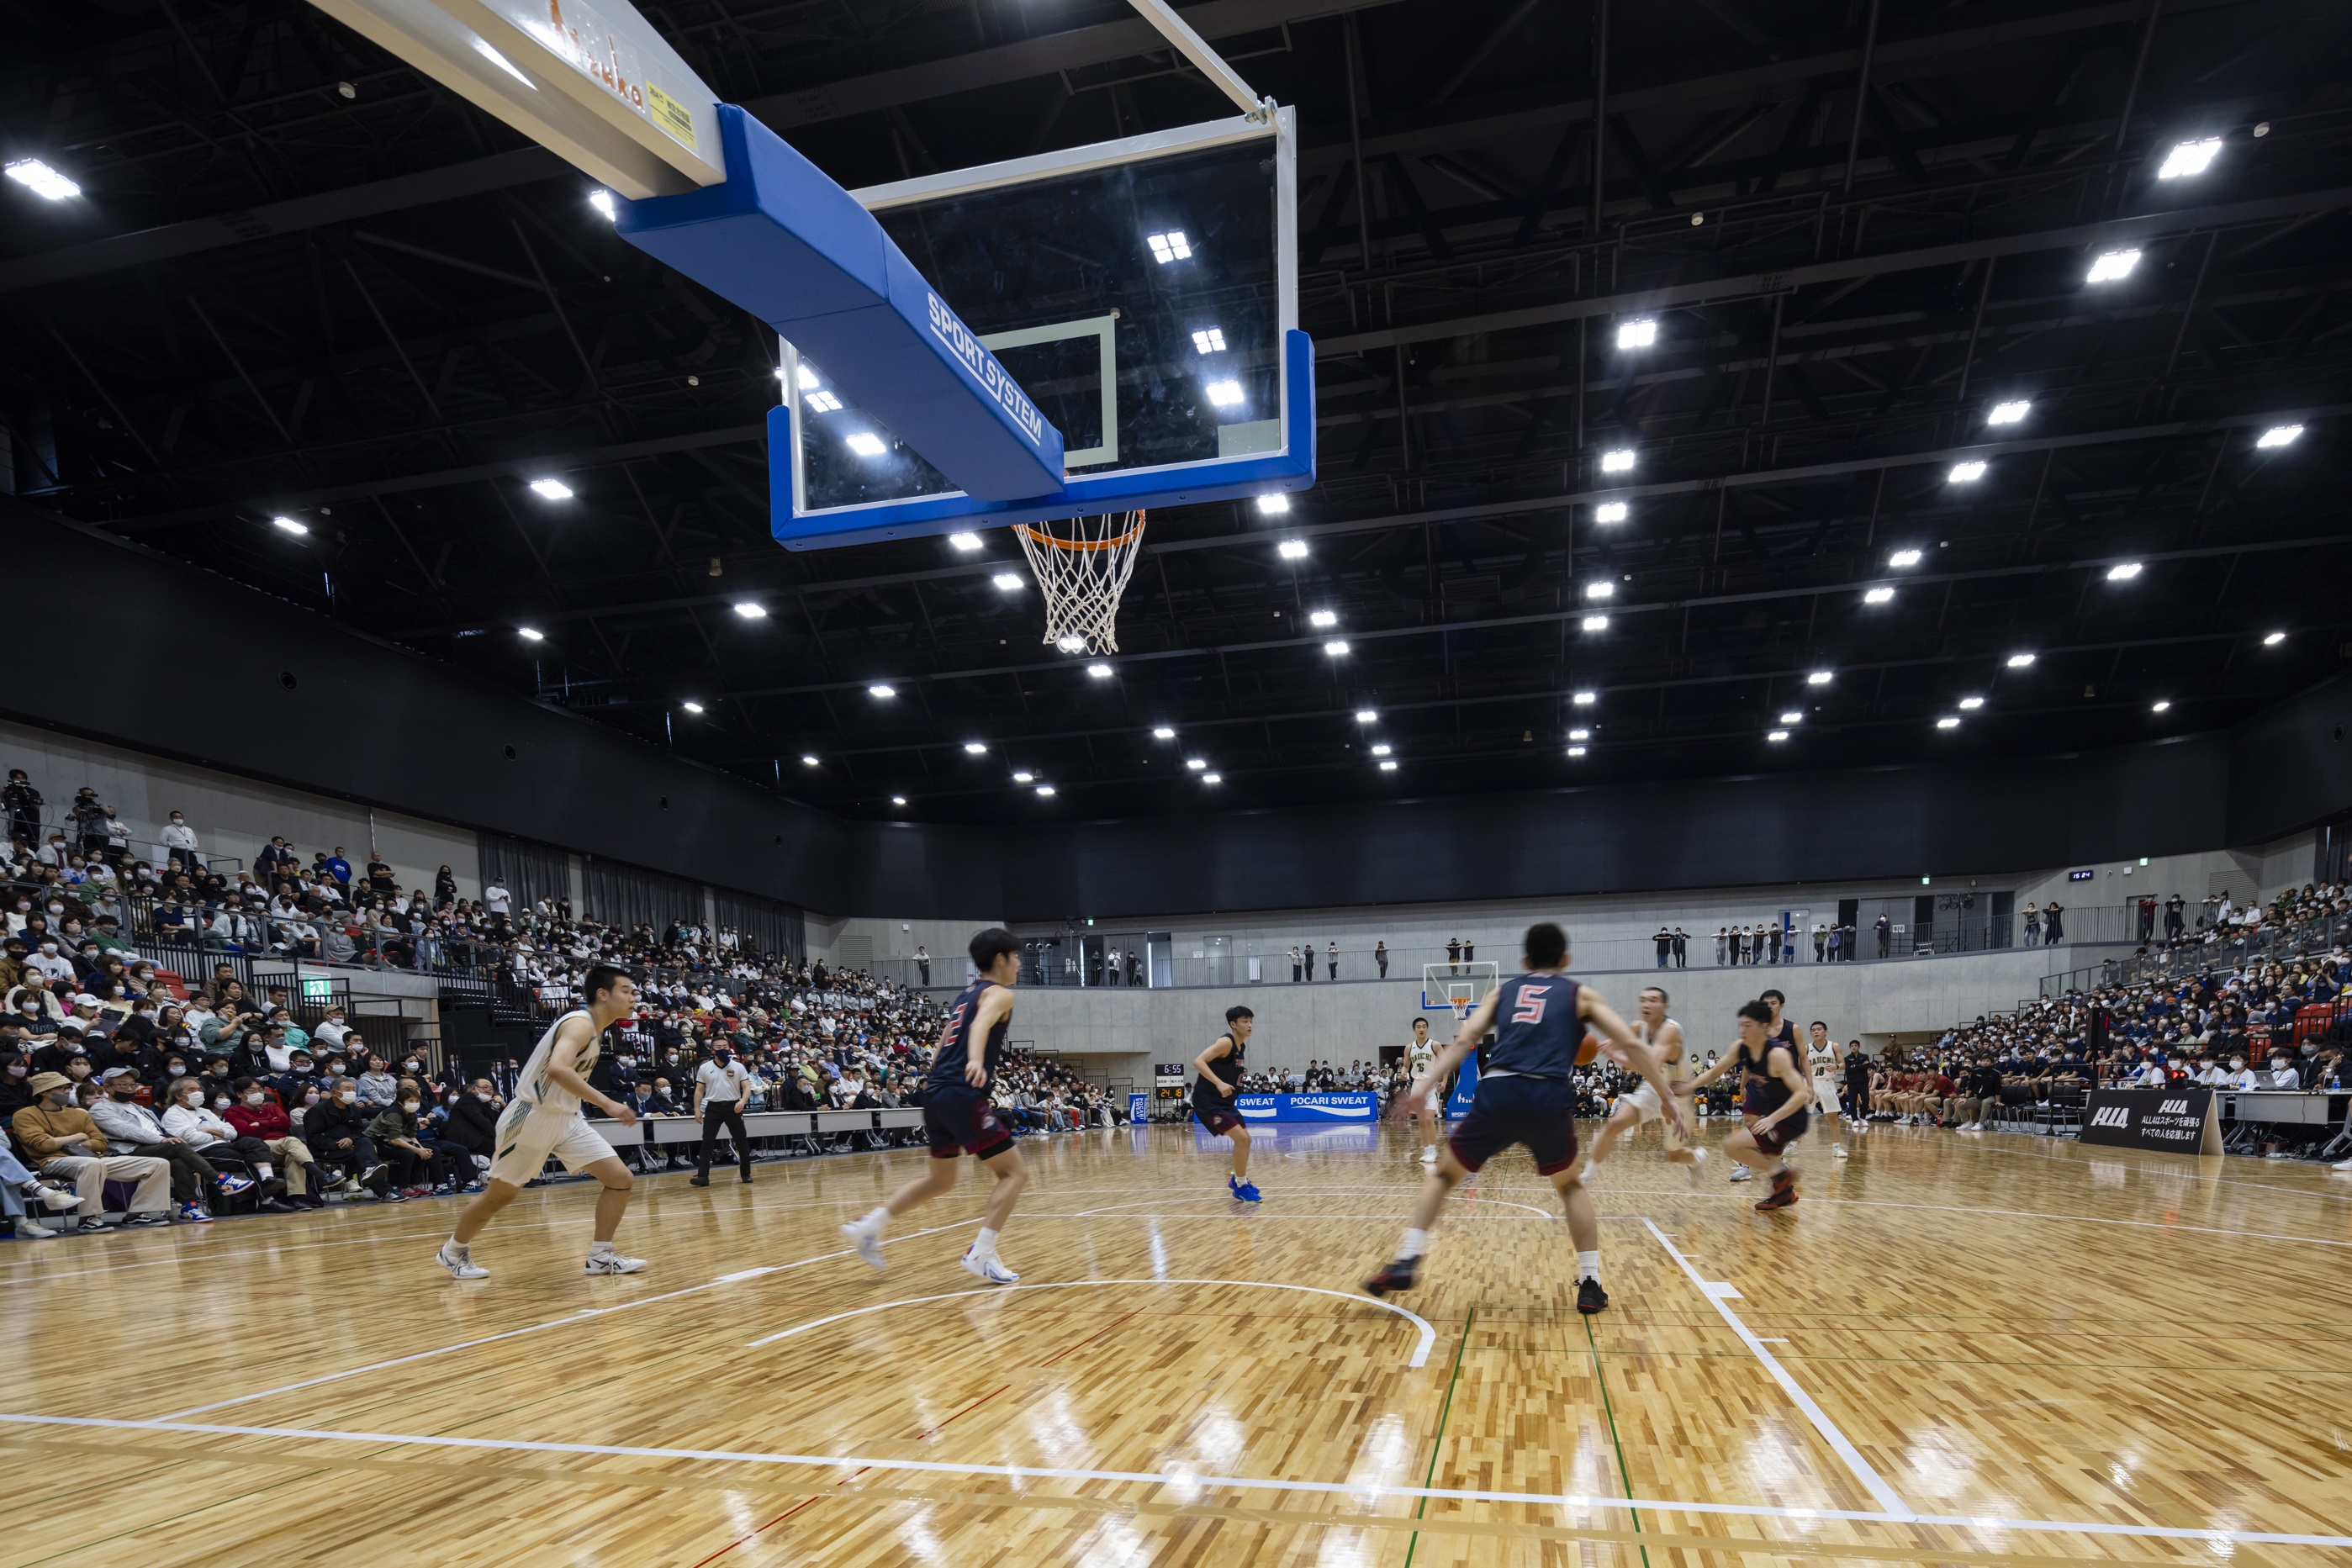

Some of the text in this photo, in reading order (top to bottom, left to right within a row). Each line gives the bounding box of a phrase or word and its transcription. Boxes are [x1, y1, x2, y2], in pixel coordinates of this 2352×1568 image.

[928, 292, 1042, 439] SPORT SYSTEM
[1511, 984, 1553, 1025] 5
[1164, 1064, 1181, 1074] 6:55
[1815, 1066, 1825, 1077] 18
[1160, 1089, 1171, 1097] 24
[1239, 1097, 1275, 1106] SWEAT
[1331, 1096, 1368, 1105] SWEAT
[2141, 1127, 2196, 1141] すべての人を応援します
